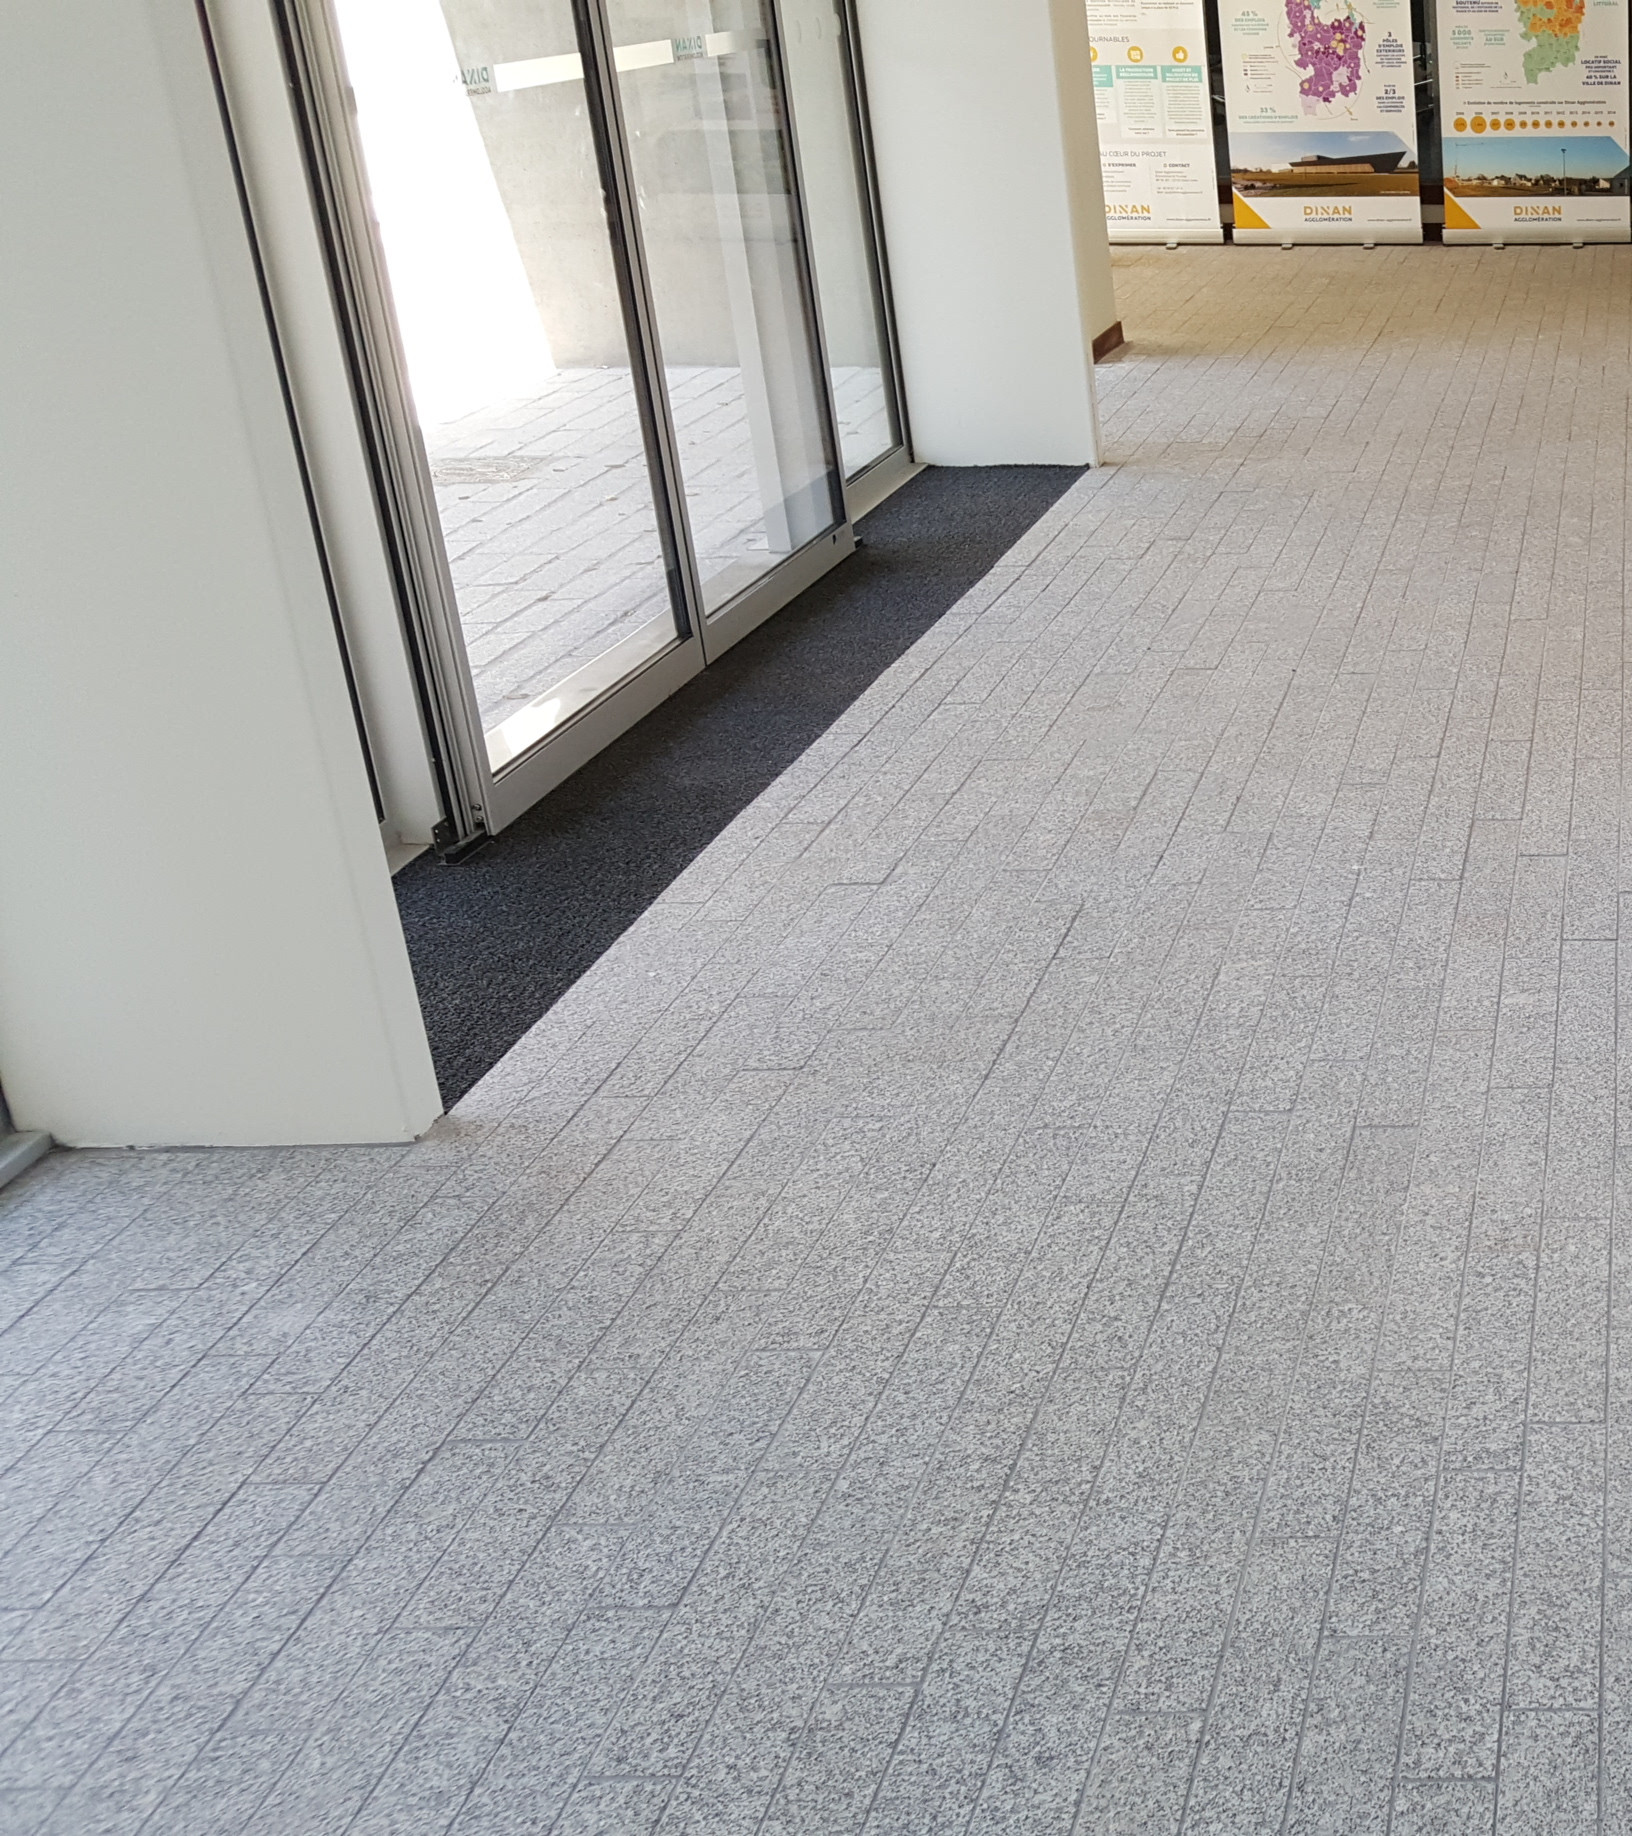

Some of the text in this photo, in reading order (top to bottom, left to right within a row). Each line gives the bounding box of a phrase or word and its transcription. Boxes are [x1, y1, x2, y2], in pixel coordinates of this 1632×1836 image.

[1130, 150, 1140, 158] DU
[1141, 150, 1167, 158] PROJET
[1105, 204, 1151, 214] DINAN
[1303, 205, 1352, 216] DINAN
[1513, 205, 1562, 216] DINAN
